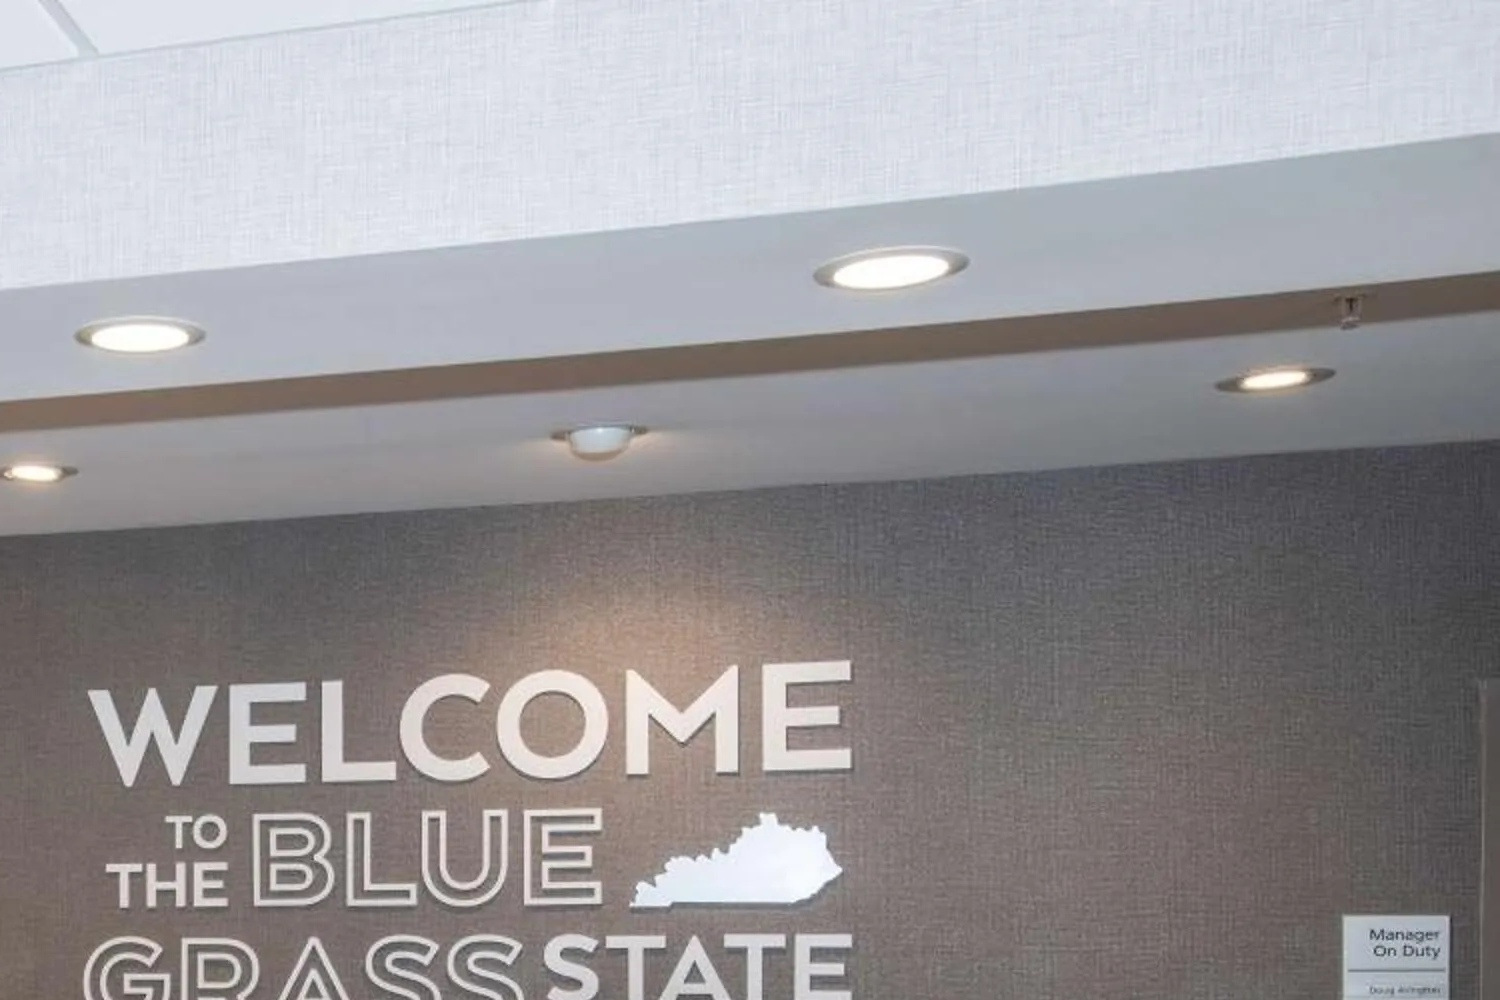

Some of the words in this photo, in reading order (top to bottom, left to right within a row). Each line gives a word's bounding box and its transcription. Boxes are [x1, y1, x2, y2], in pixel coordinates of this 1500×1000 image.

[87, 659, 853, 788] WELCOME
[164, 813, 229, 850] TO
[105, 861, 229, 909] THE
[252, 807, 603, 909] BLUE
[1369, 928, 1439, 945] Manager
[1373, 945, 1397, 957] On
[1403, 945, 1441, 960] Duty
